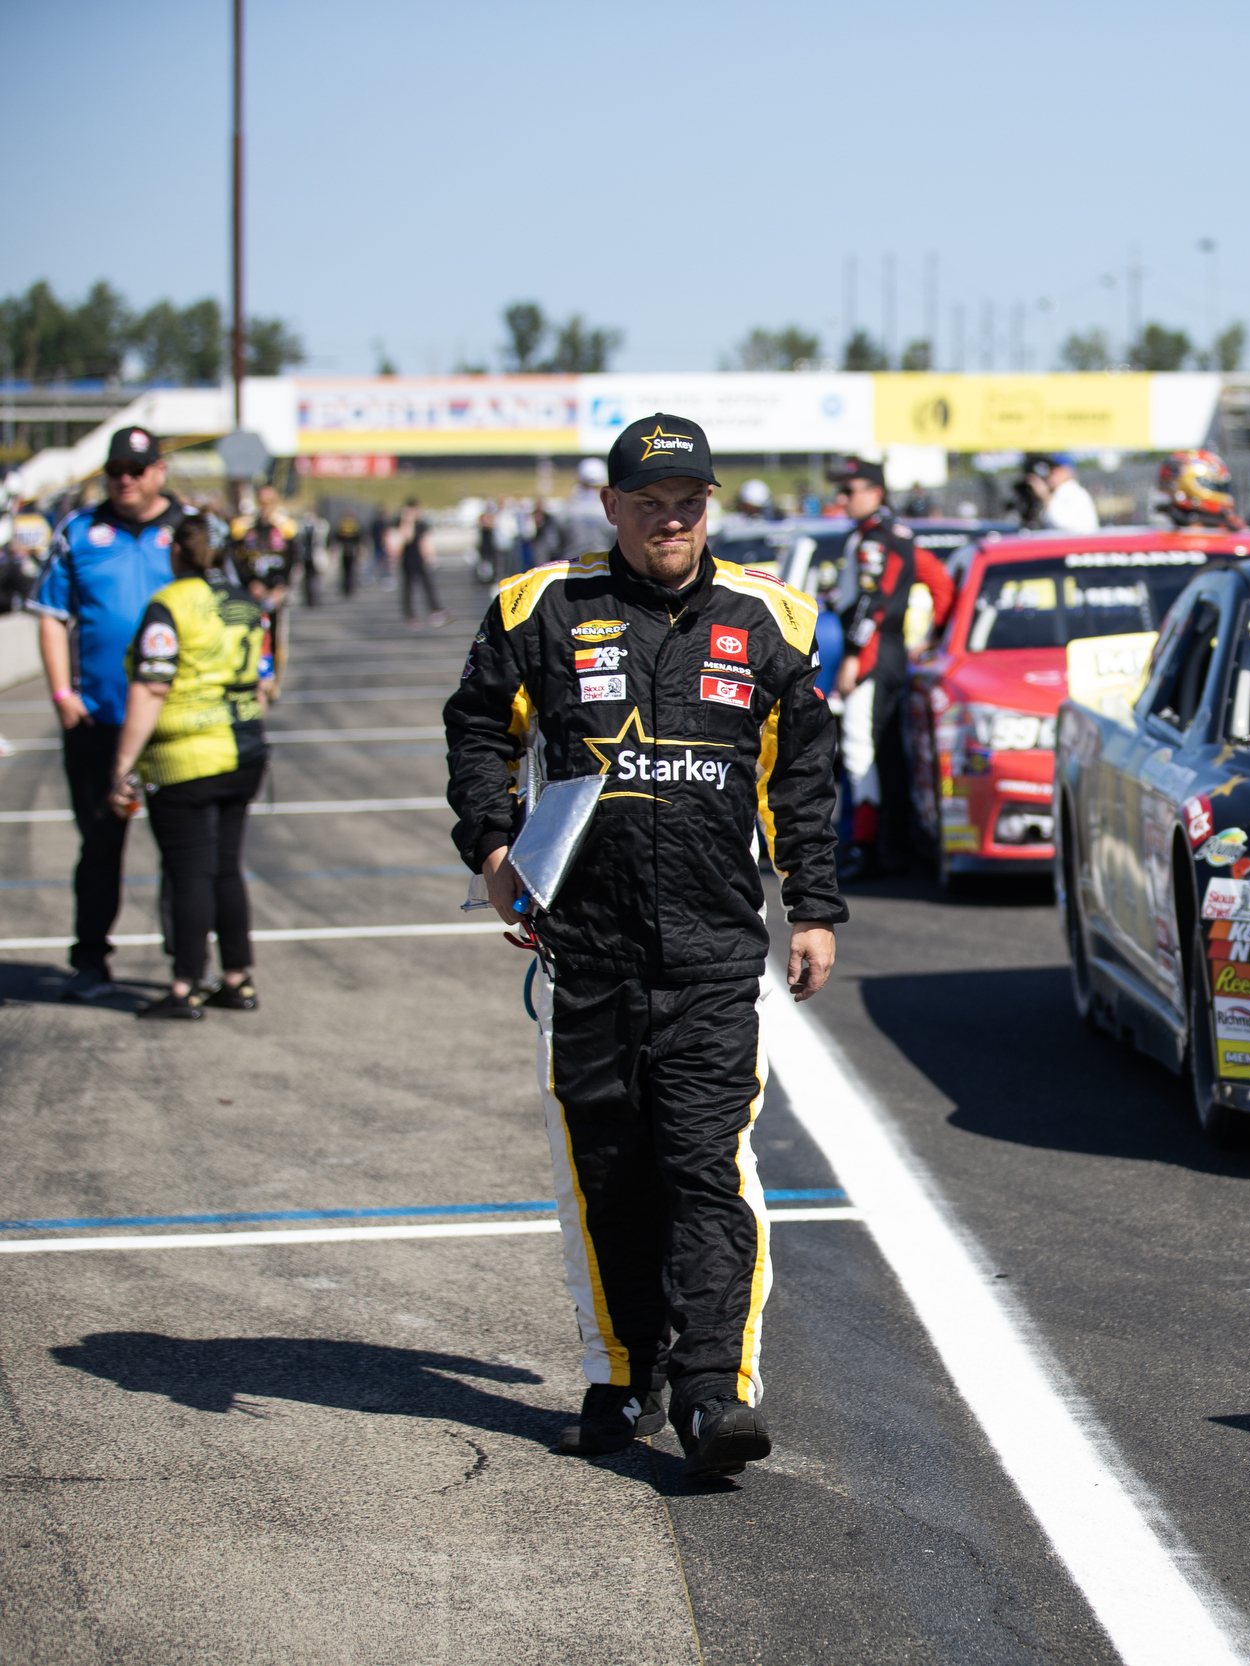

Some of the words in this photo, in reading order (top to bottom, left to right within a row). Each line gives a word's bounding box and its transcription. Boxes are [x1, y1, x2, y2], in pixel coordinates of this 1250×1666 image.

[653, 437, 694, 453] Starkey
[781, 599, 799, 631] IMPACT
[571, 623, 628, 636] MENARDS
[703, 661, 752, 676] MENARDS
[583, 685, 605, 693] Sioux
[583, 692, 603, 700] Chief
[617, 749, 733, 790] Starkey
[1207, 889, 1237, 904] Sioux
